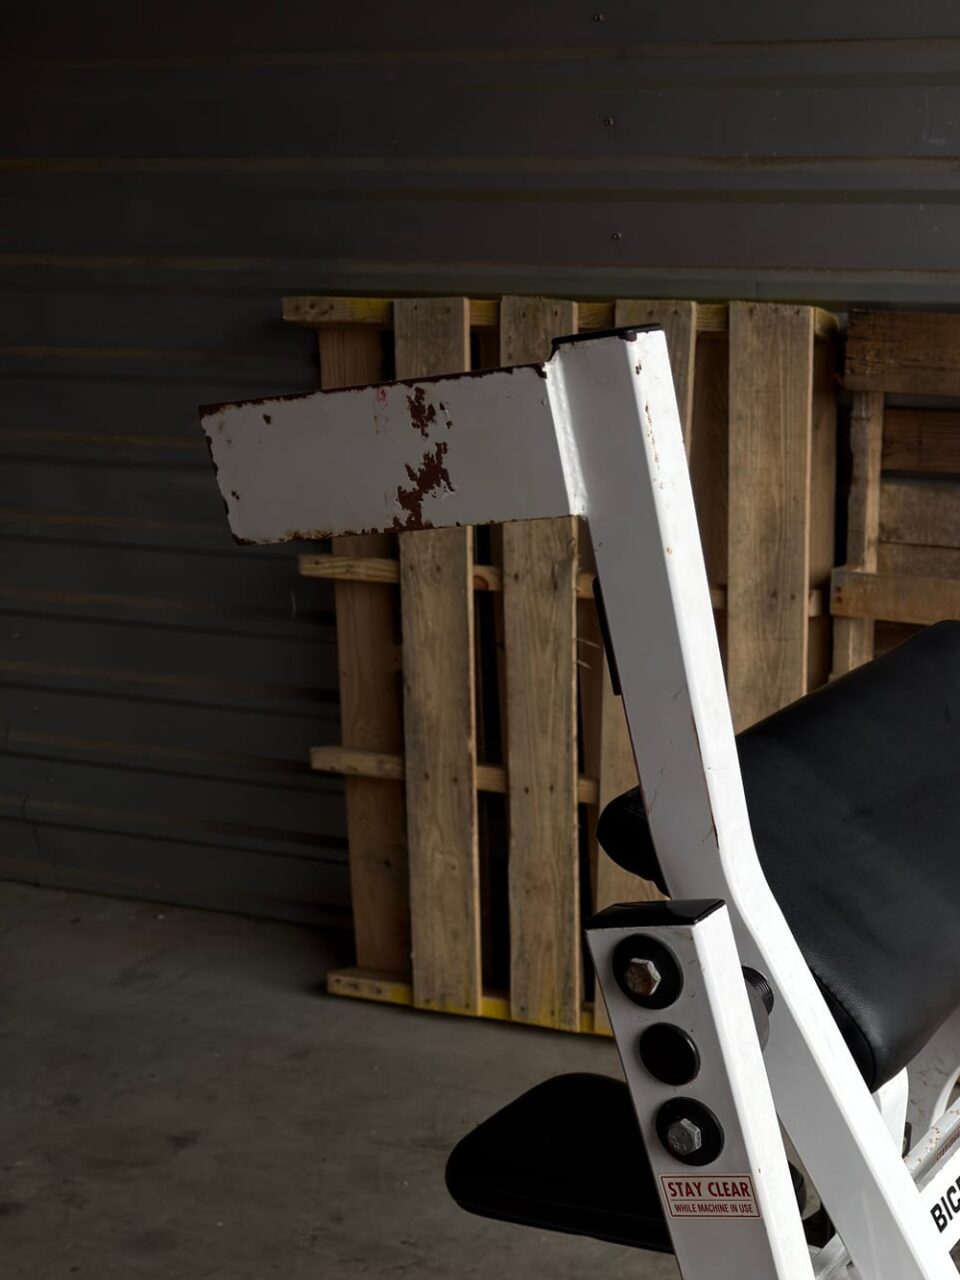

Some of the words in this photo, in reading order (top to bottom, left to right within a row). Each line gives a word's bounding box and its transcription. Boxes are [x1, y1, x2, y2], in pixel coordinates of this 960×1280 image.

[668, 1182, 702, 1197] STAY
[707, 1182, 750, 1197] CLEAR
[675, 1203, 697, 1213] WHILE
[698, 1203, 729, 1213] MACHINE
[730, 1203, 738, 1213] IN
[739, 1203, 753, 1213] USE
